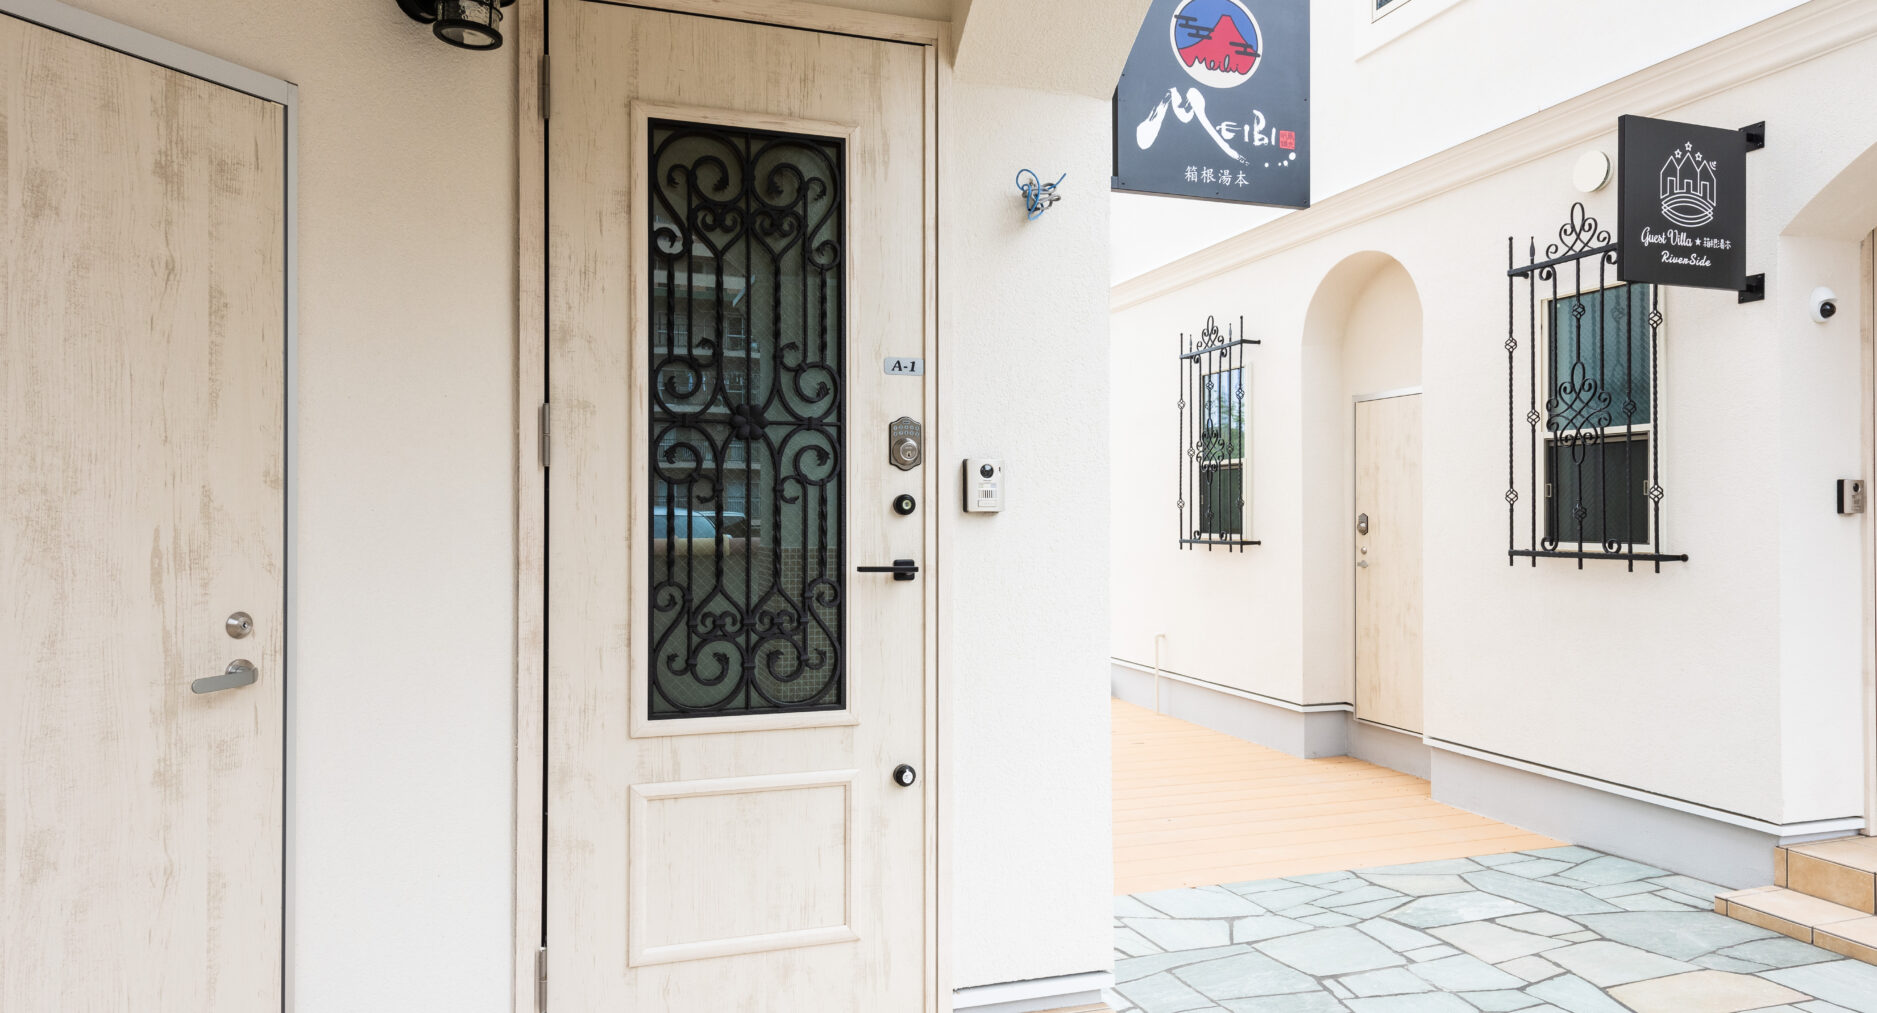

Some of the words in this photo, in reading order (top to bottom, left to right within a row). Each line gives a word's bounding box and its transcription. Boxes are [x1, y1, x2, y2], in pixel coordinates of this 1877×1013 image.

[1184, 165, 1249, 187] 箱根湯本
[1641, 226, 1667, 246] Guest
[1667, 229, 1693, 247] Villa
[891, 360, 916, 372] A-1
